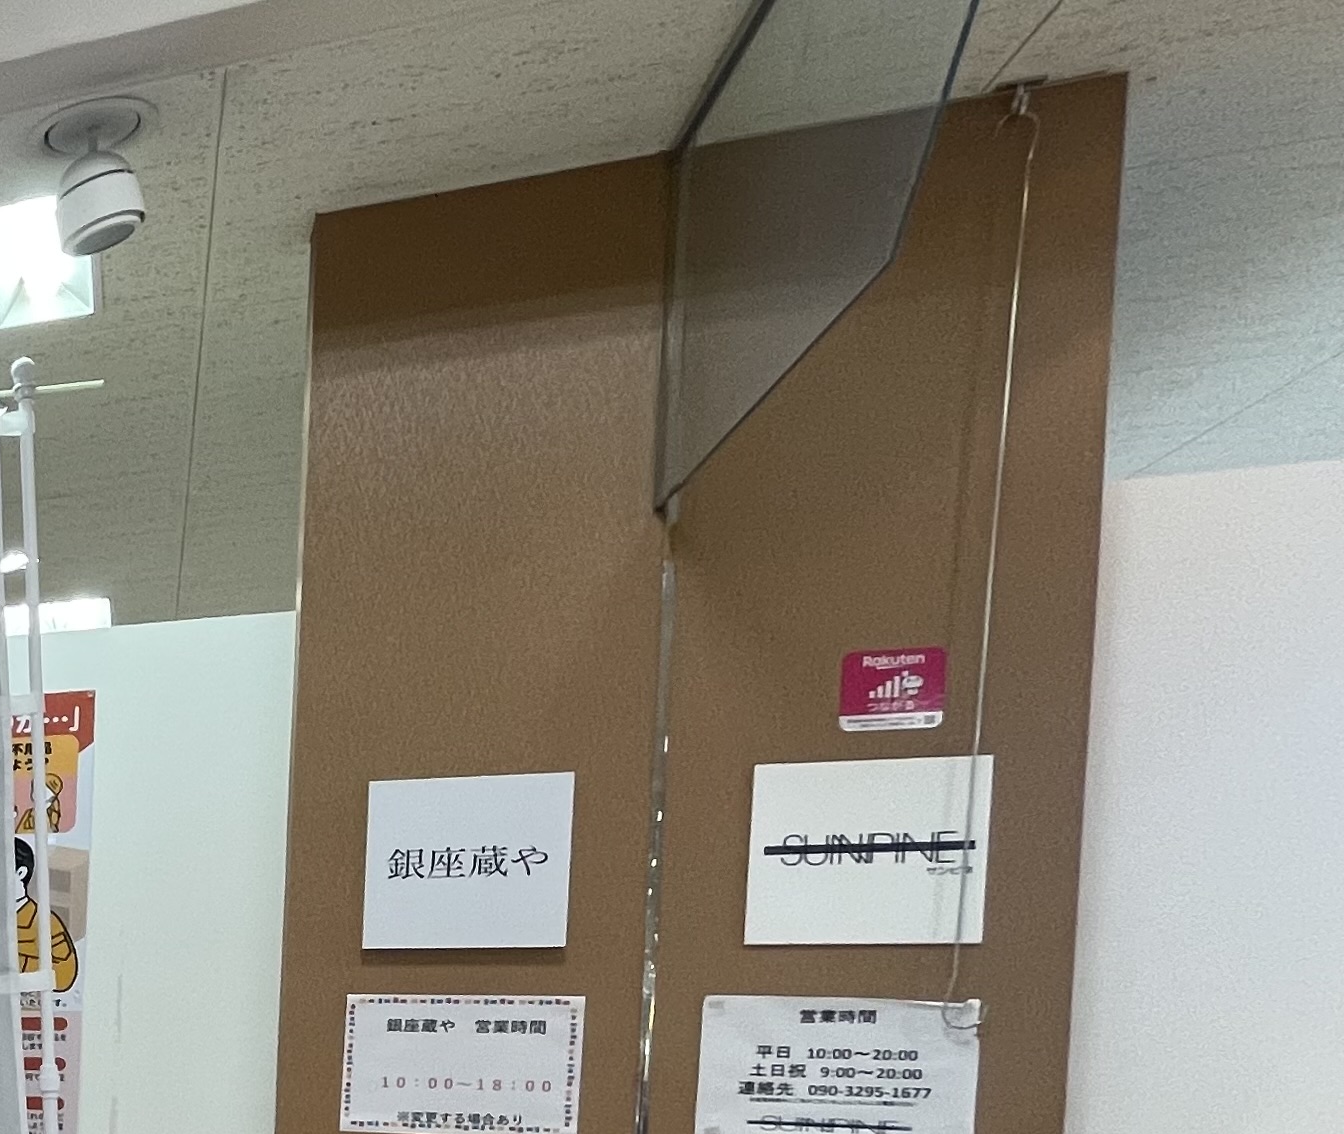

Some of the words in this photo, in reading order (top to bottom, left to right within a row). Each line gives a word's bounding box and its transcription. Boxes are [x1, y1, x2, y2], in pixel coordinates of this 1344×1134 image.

[863, 654, 925, 668] Rakuten
[387, 844, 549, 881] 銀座蔵や
[799, 1009, 878, 1025] 営業時間
[386, 1017, 456, 1034] 銀座蔵や
[474, 1017, 548, 1035] 営業時間
[756, 1045, 792, 1060] 平日
[749, 1064, 807, 1079] 土日祝
[737, 1081, 795, 1097] 連絡先
